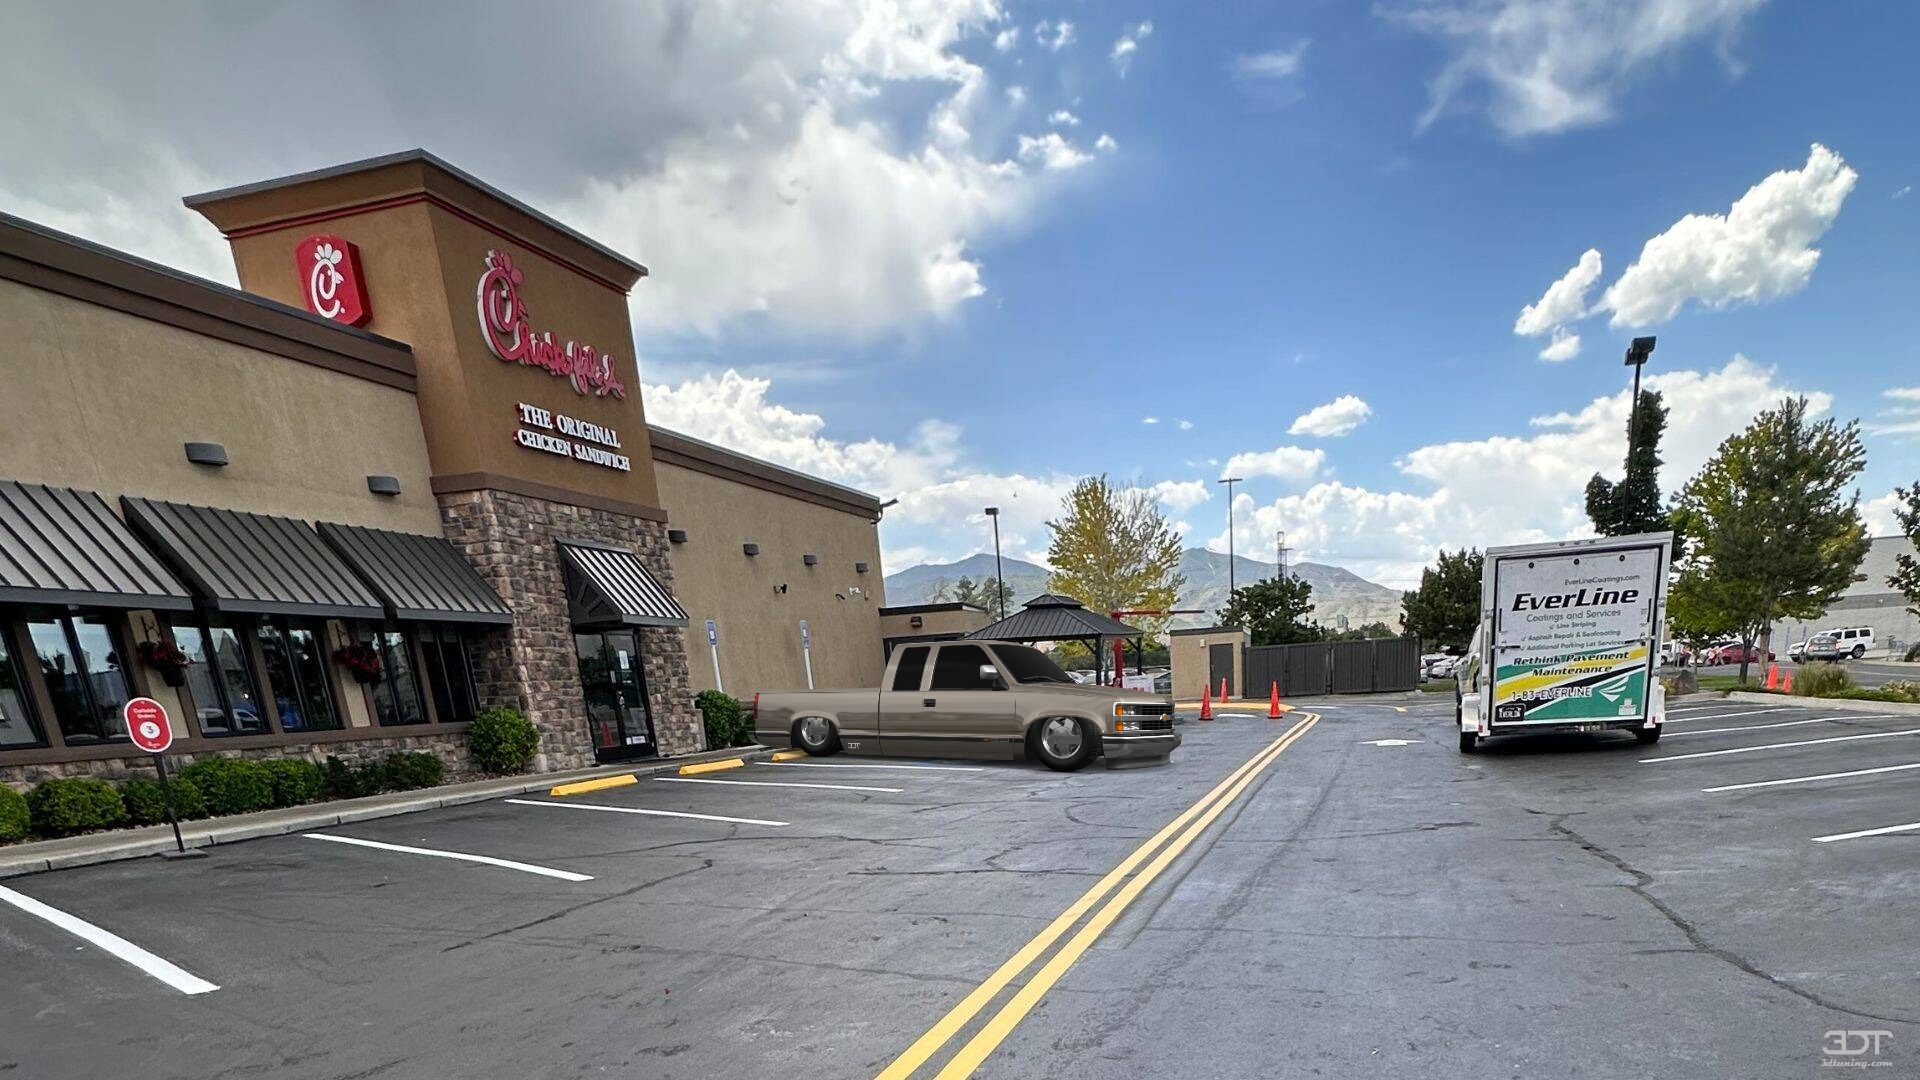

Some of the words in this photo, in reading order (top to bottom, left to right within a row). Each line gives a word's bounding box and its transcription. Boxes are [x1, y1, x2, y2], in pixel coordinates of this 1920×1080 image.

[519, 402, 553, 430] THE
[556, 414, 622, 448] ORIGINAL
[517, 428, 573, 458] CHICKEN
[573, 443, 631, 472] SANDWICH
[1564, 574, 1641, 586] EverLineCoatings.com
[1511, 587, 1639, 612] EverLine
[1526, 612, 1564, 623] Coatings
[1566, 610, 1584, 620] and
[1586, 608, 1621, 619] Services
[1554, 632, 1575, 640] Repair
[1513, 653, 1562, 666] Rethink
[1565, 650, 1630, 663] Pavement
[1531, 665, 1613, 677] Maintenance
[1511, 687, 1592, 701] 1-83-EVERLINE
[146, 725, 154, 734] 3
